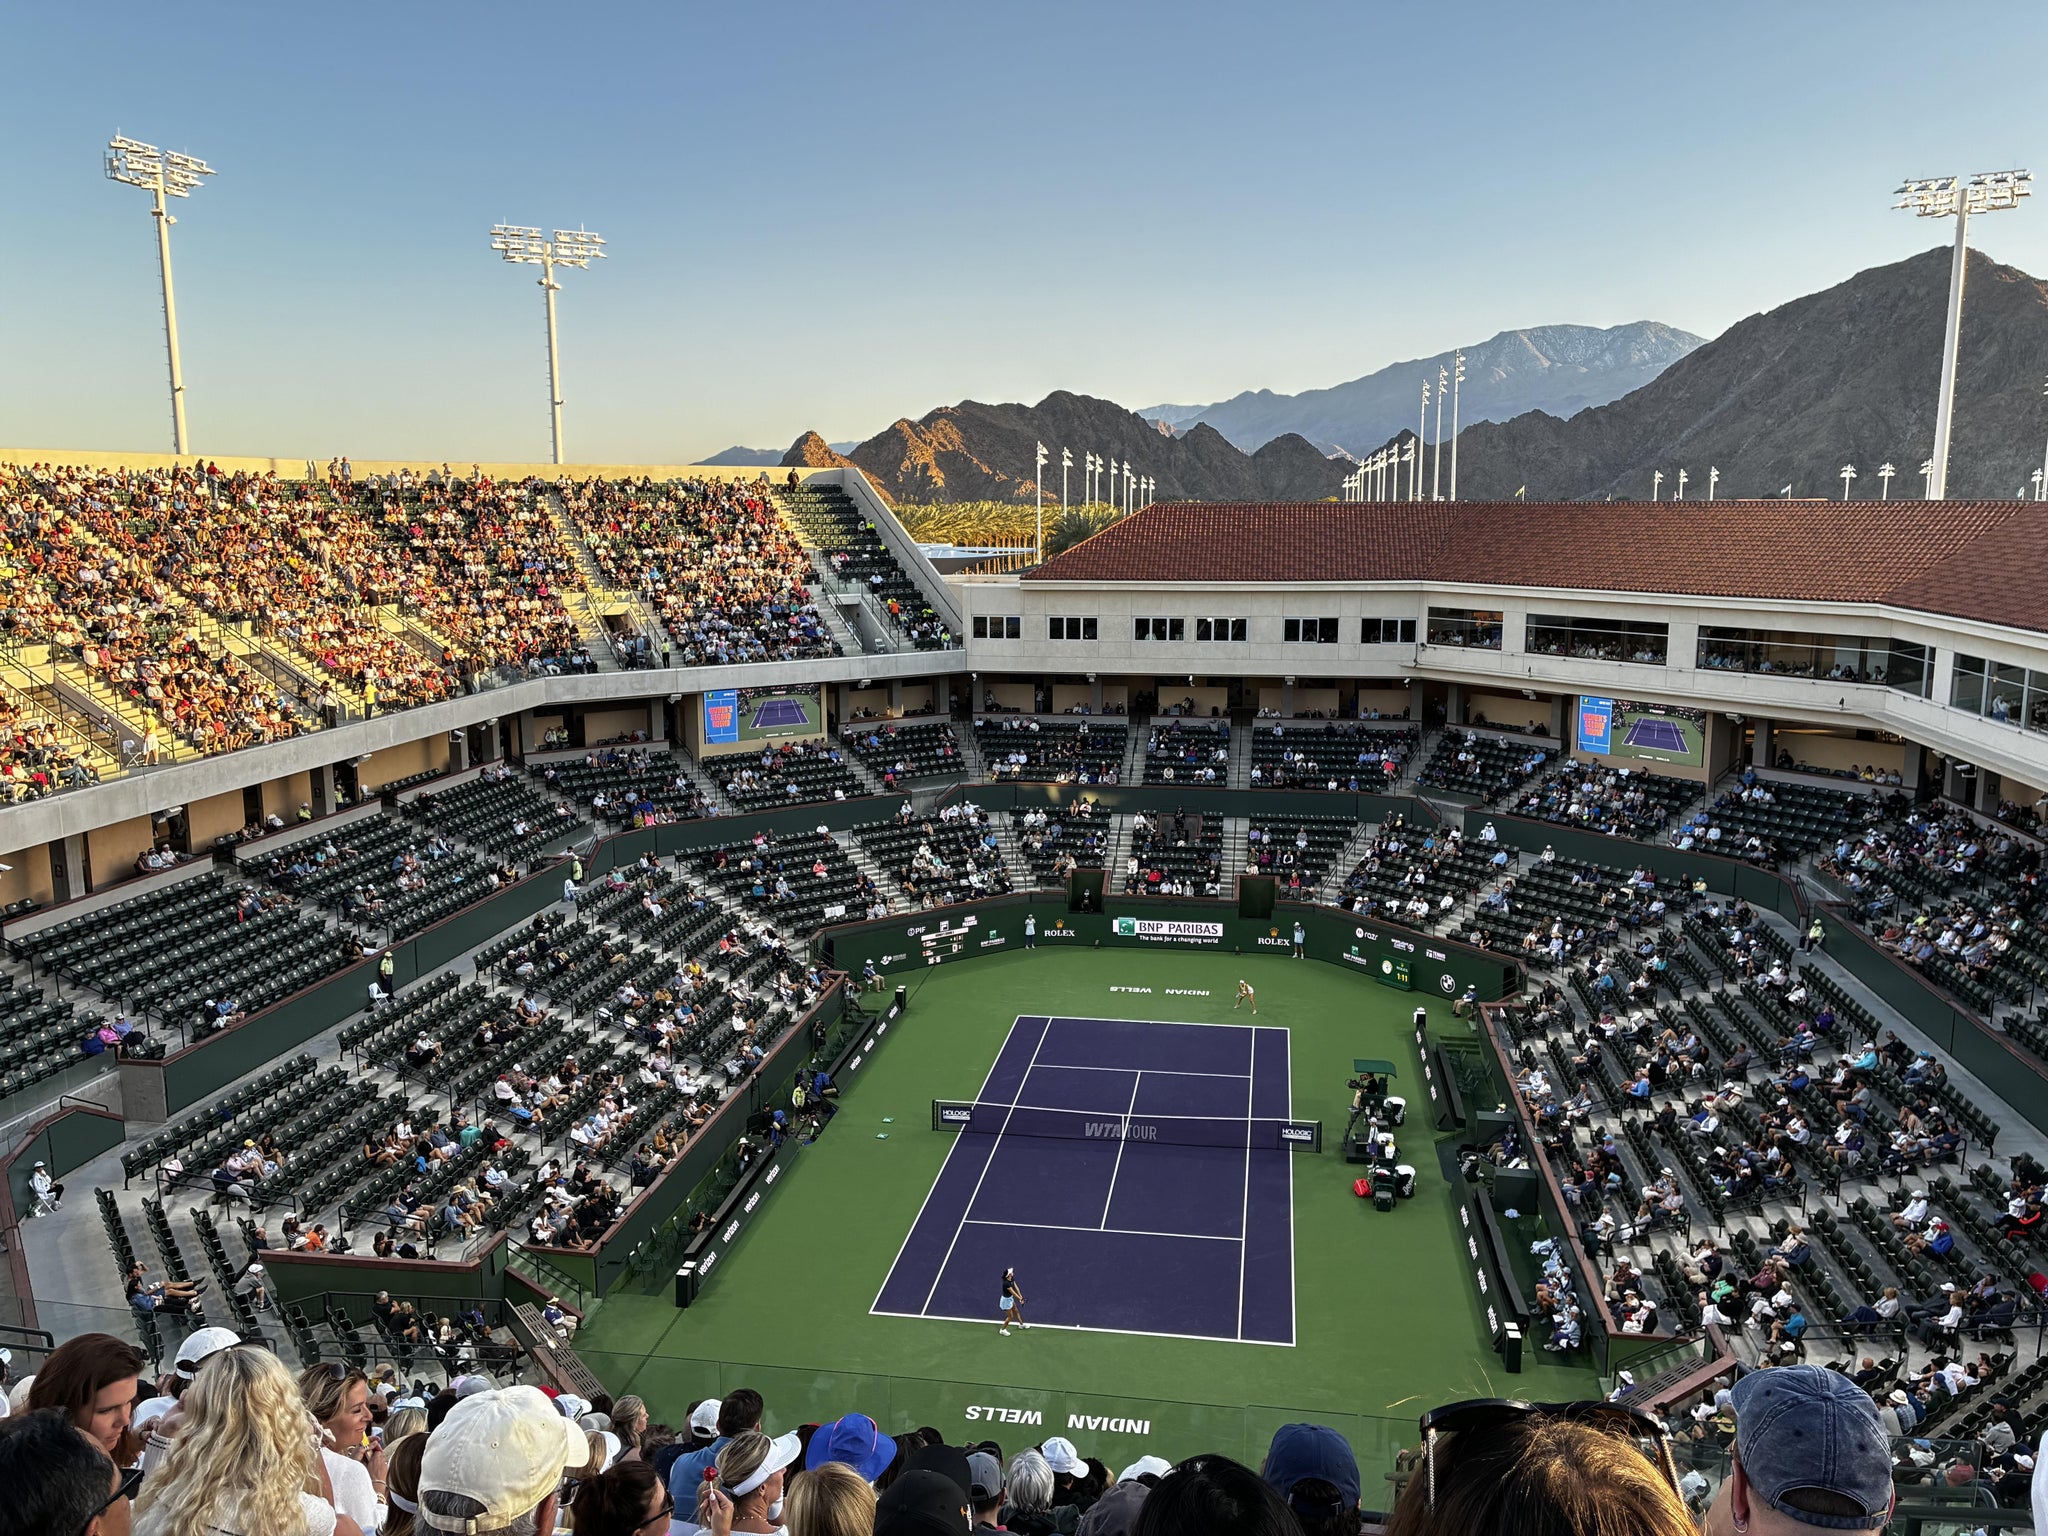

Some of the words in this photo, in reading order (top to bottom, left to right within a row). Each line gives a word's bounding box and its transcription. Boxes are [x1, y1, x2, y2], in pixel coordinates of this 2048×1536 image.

[915, 926, 926, 934] PIF
[1140, 922, 1163, 932] BNP
[1168, 923, 1218, 935] PARIBAS
[1364, 932, 1378, 941] razr
[1258, 938, 1290, 946] ROLEX
[1110, 986, 1152, 994] WELLS
[1085, 1122, 1121, 1137] WTA
[1127, 1125, 1157, 1140] TOUR
[1282, 1128, 1312, 1136] HOLOGIC
[765, 1164, 780, 1185] verizon
[744, 1191, 760, 1213] verizon
[722, 1220, 740, 1243] verizon
[1468, 1234, 1478, 1260] verizon
[698, 1251, 717, 1276] verizon
[1477, 1266, 1488, 1295] verizon
[1487, 1304, 1498, 1334] verizon
[965, 1405, 1042, 1426] WELLS
[1067, 1414, 1151, 1435] INDIAN
